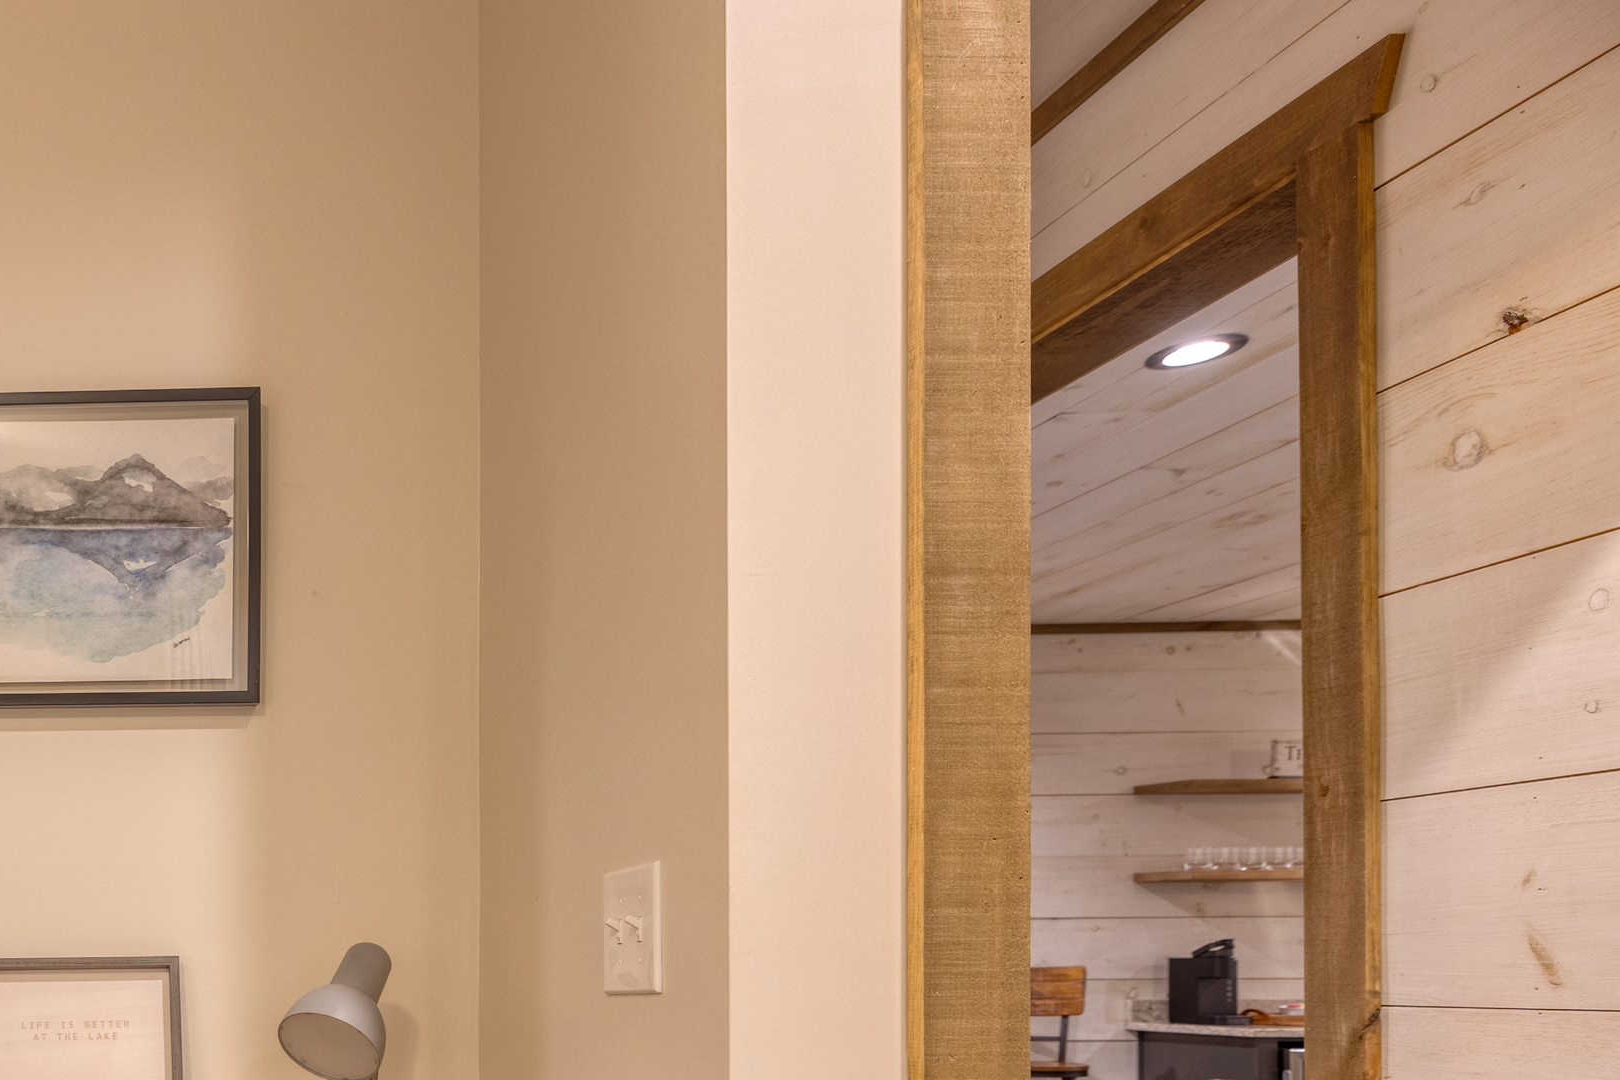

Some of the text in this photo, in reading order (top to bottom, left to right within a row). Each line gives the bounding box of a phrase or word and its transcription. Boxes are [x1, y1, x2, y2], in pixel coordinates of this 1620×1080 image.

[21, 1020, 130, 1030] LIFE IS BETTER
[33, 1032, 118, 1041] AT THE LAKE
